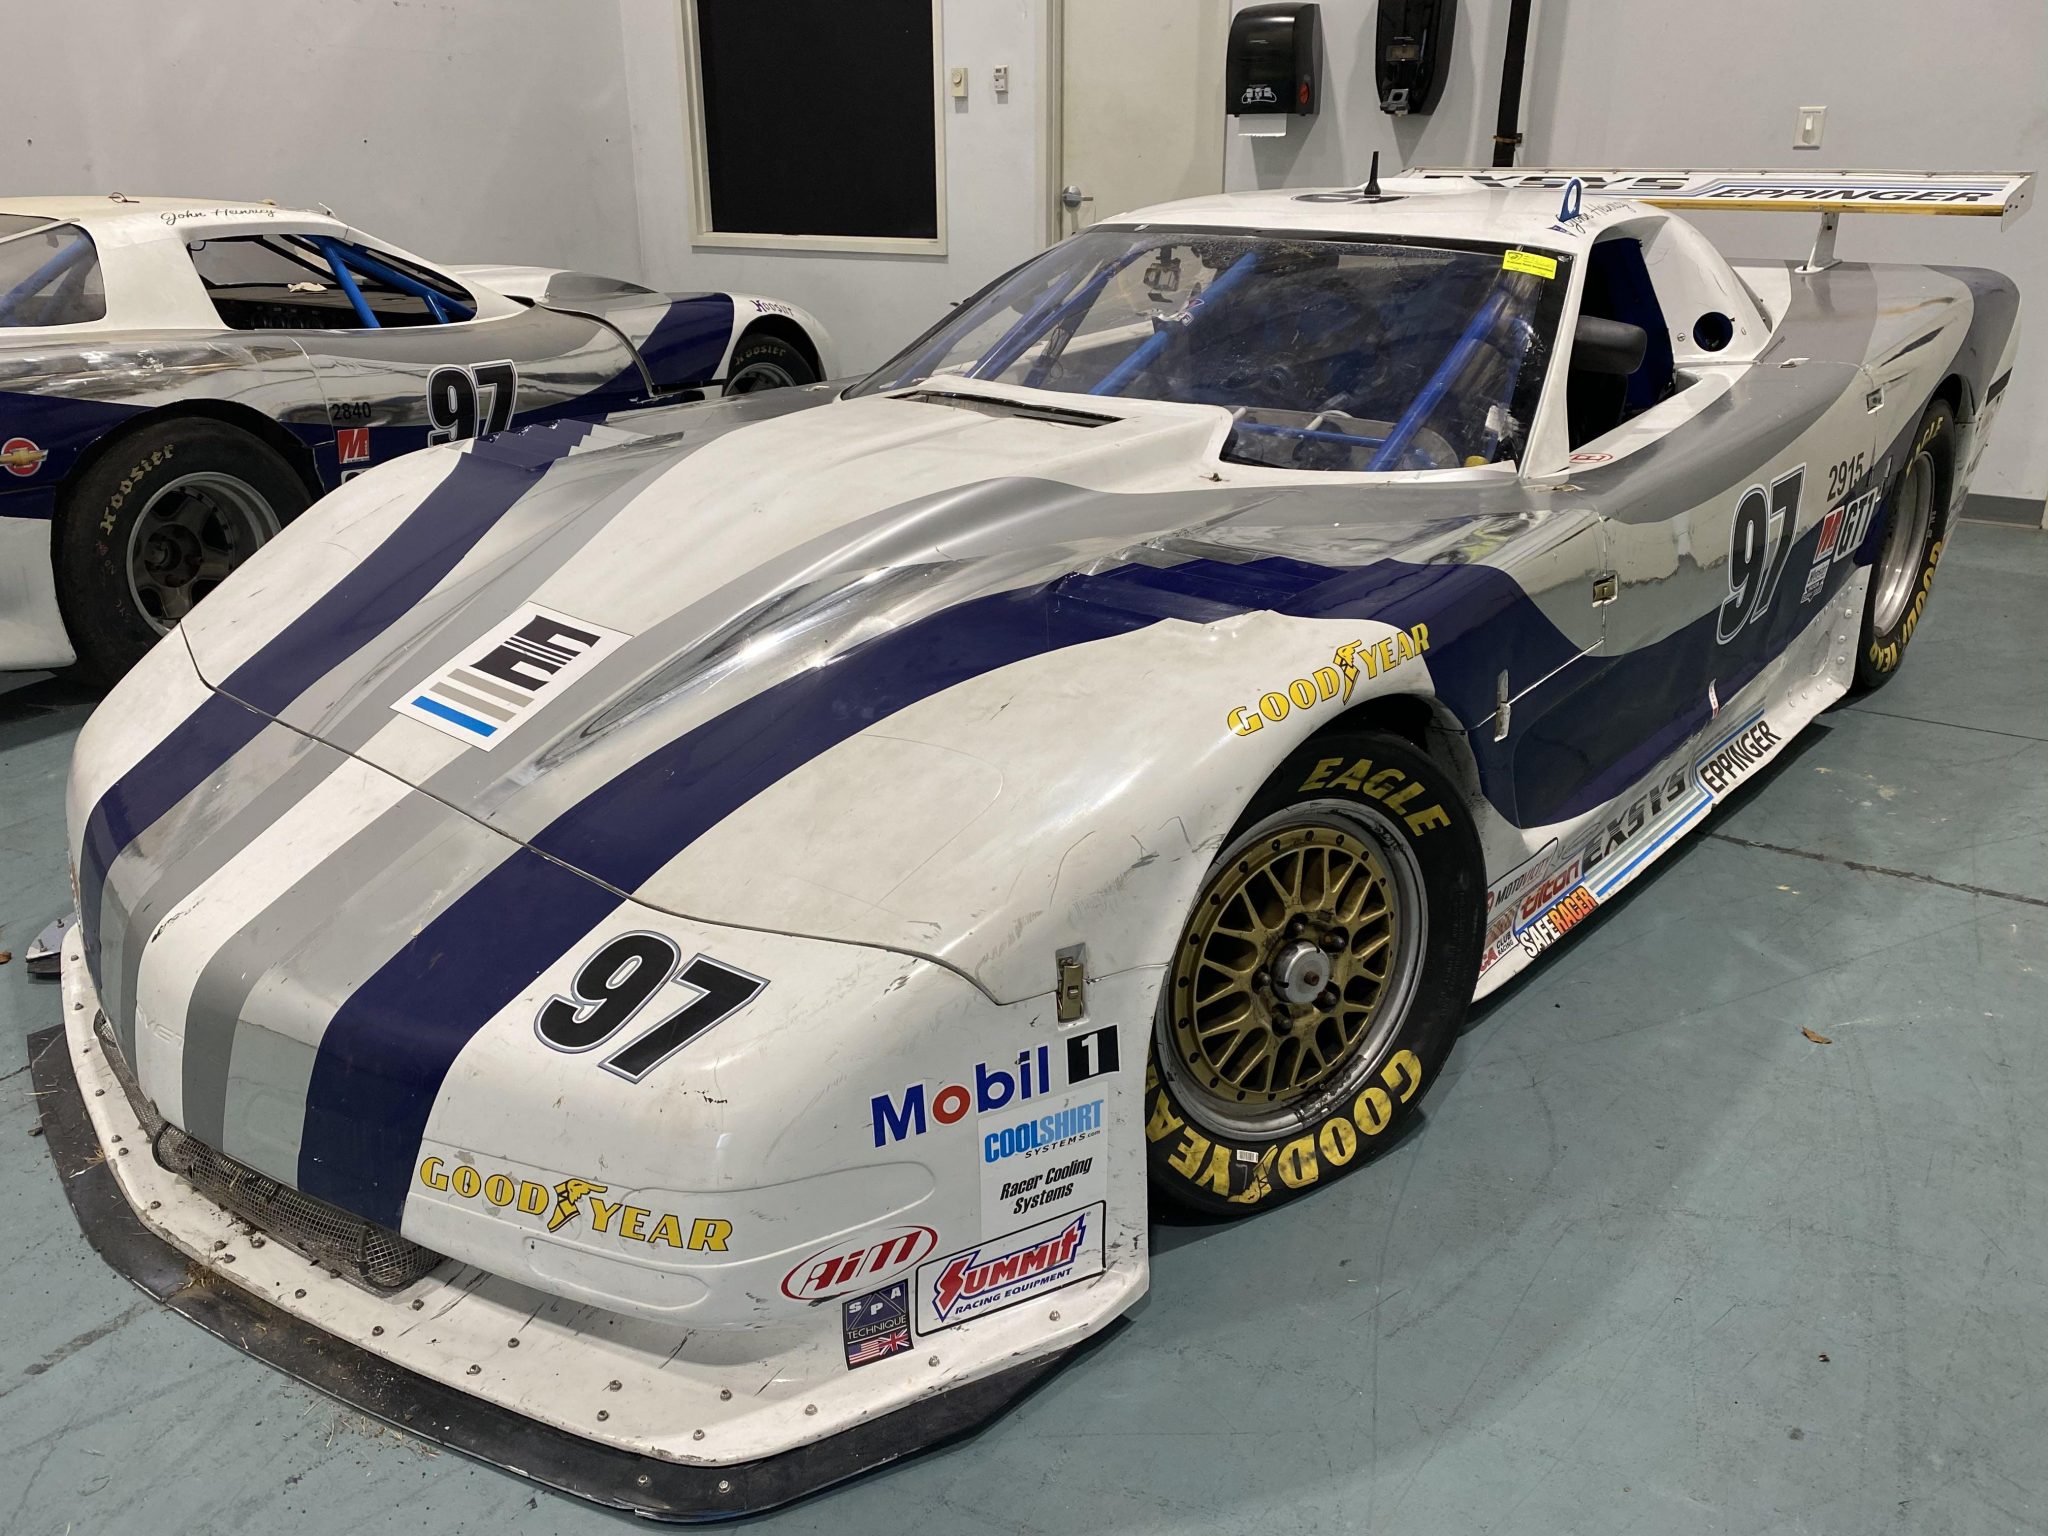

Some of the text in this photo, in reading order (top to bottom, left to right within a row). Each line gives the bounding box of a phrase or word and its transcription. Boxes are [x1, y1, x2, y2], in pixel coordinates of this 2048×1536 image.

[1424, 175, 1690, 190] XSYS
[1708, 188, 1993, 202] EPPINGER
[331, 401, 372, 421] 2840
[426, 359, 518, 448] 97
[100, 444, 175, 536] Hoosier
[1826, 451, 1865, 502] 2915
[1716, 462, 1807, 645] 97
[1838, 490, 1876, 557] GT1
[1227, 623, 1431, 737] GOODYEAR
[1700, 720, 1782, 794] EPPINGER
[1298, 757, 1452, 837] EAGLE
[1520, 860, 1580, 920] tilton
[1480, 947, 1498, 971] CA
[1496, 931, 1511, 949] CLUB
[534, 930, 771, 1084] 97
[870, 1044, 1050, 1149] Mobil
[984, 1098, 1104, 1164] COOLSHIRT
[419, 1156, 733, 1252] GOODYEAR
[1000, 1156, 1093, 1200] Racer Cooling
[1013, 1182, 1074, 1215] Systems
[955, 1267, 1073, 1315] RACING EQUIPMENT
[846, 1314, 907, 1341] TECHNIQUE
